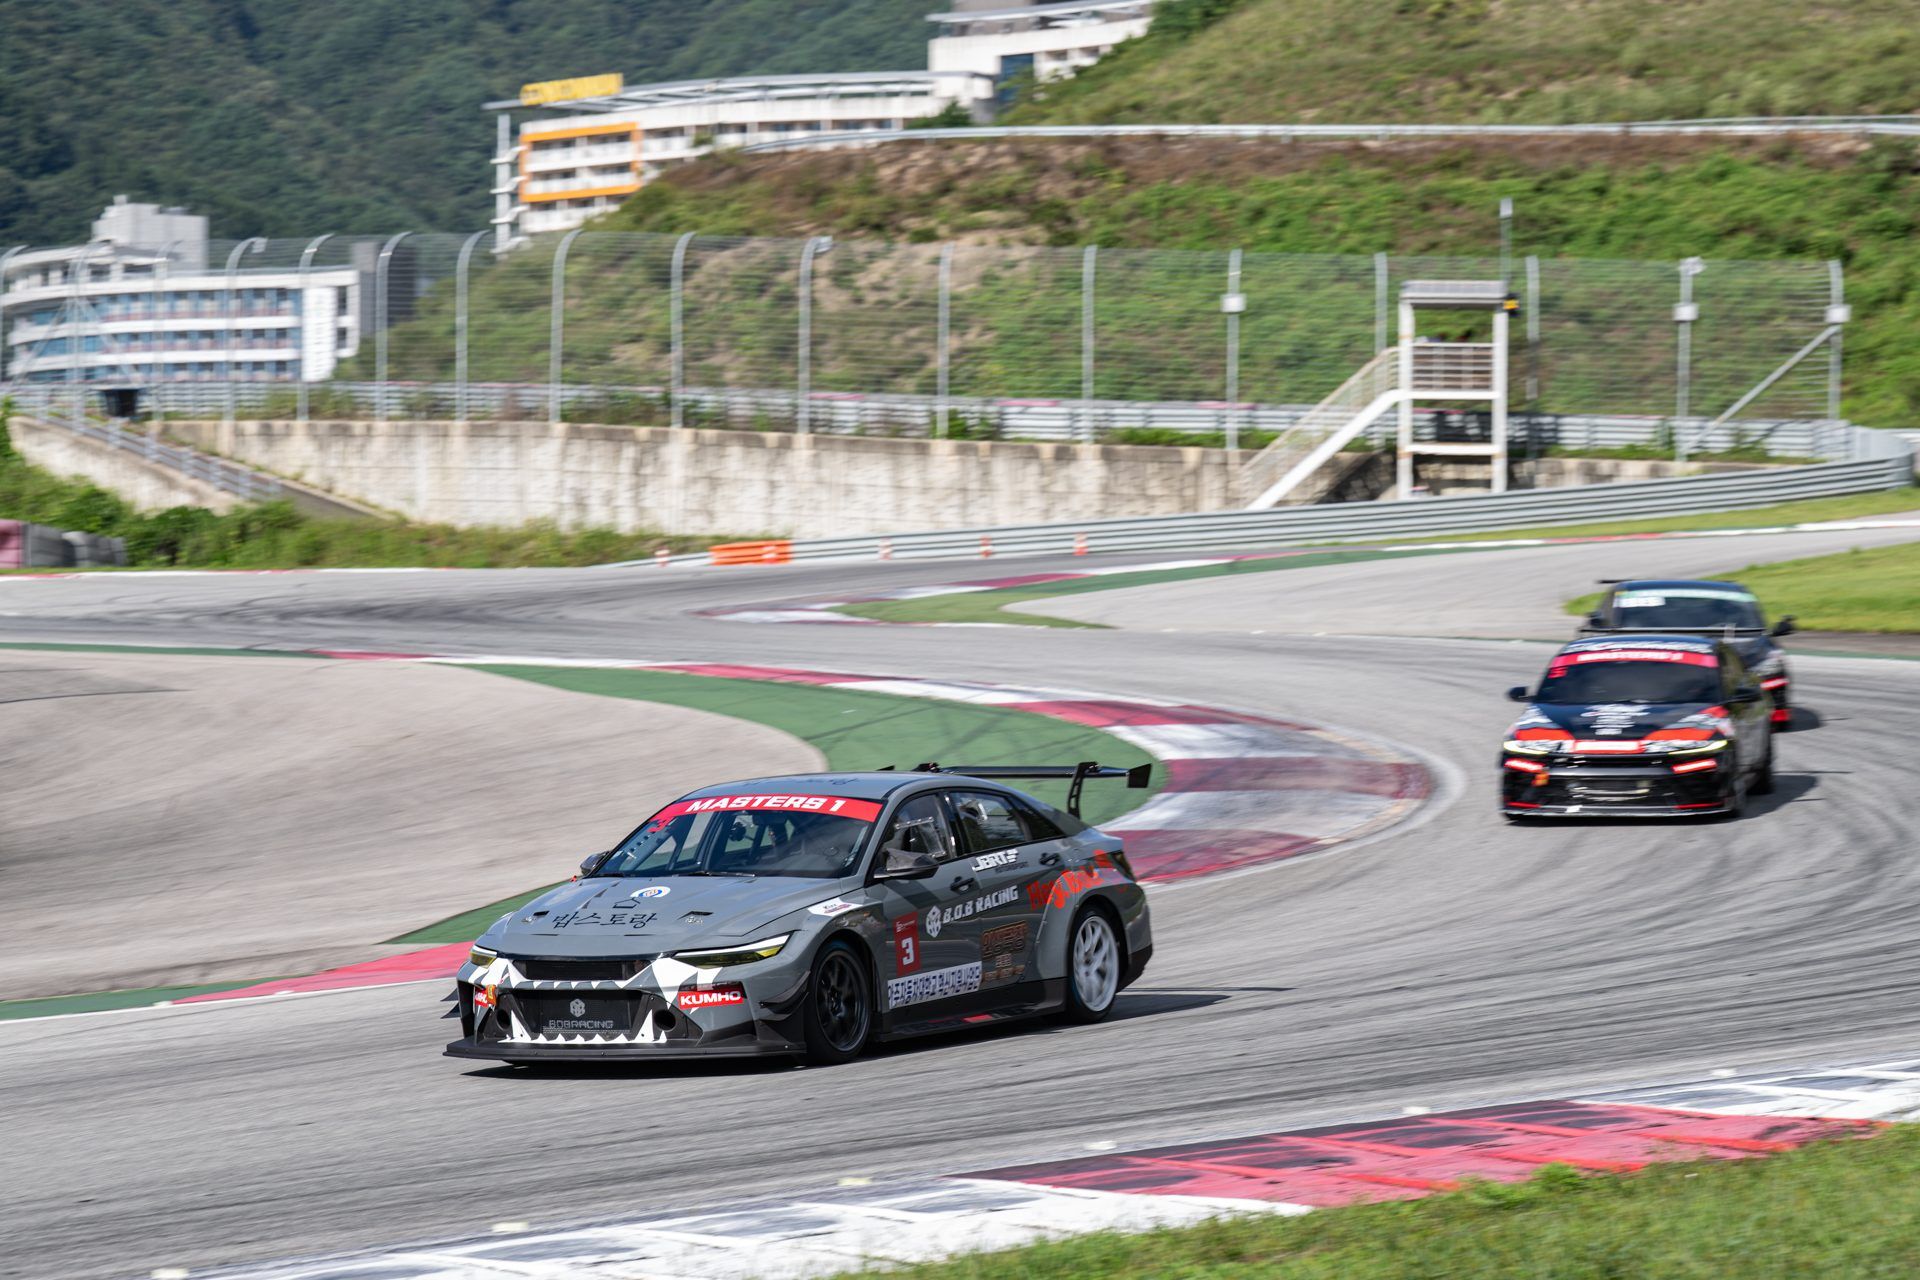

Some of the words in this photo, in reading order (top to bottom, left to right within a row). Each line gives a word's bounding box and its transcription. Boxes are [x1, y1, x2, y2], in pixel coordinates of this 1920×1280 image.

[685, 796, 828, 813] MASTERS
[829, 800, 846, 812] 1
[552, 911, 658, 929] 밥스토랑
[943, 900, 974, 924] B.O.B
[901, 937, 914, 966] 3
[680, 991, 741, 1006] KUMHO
